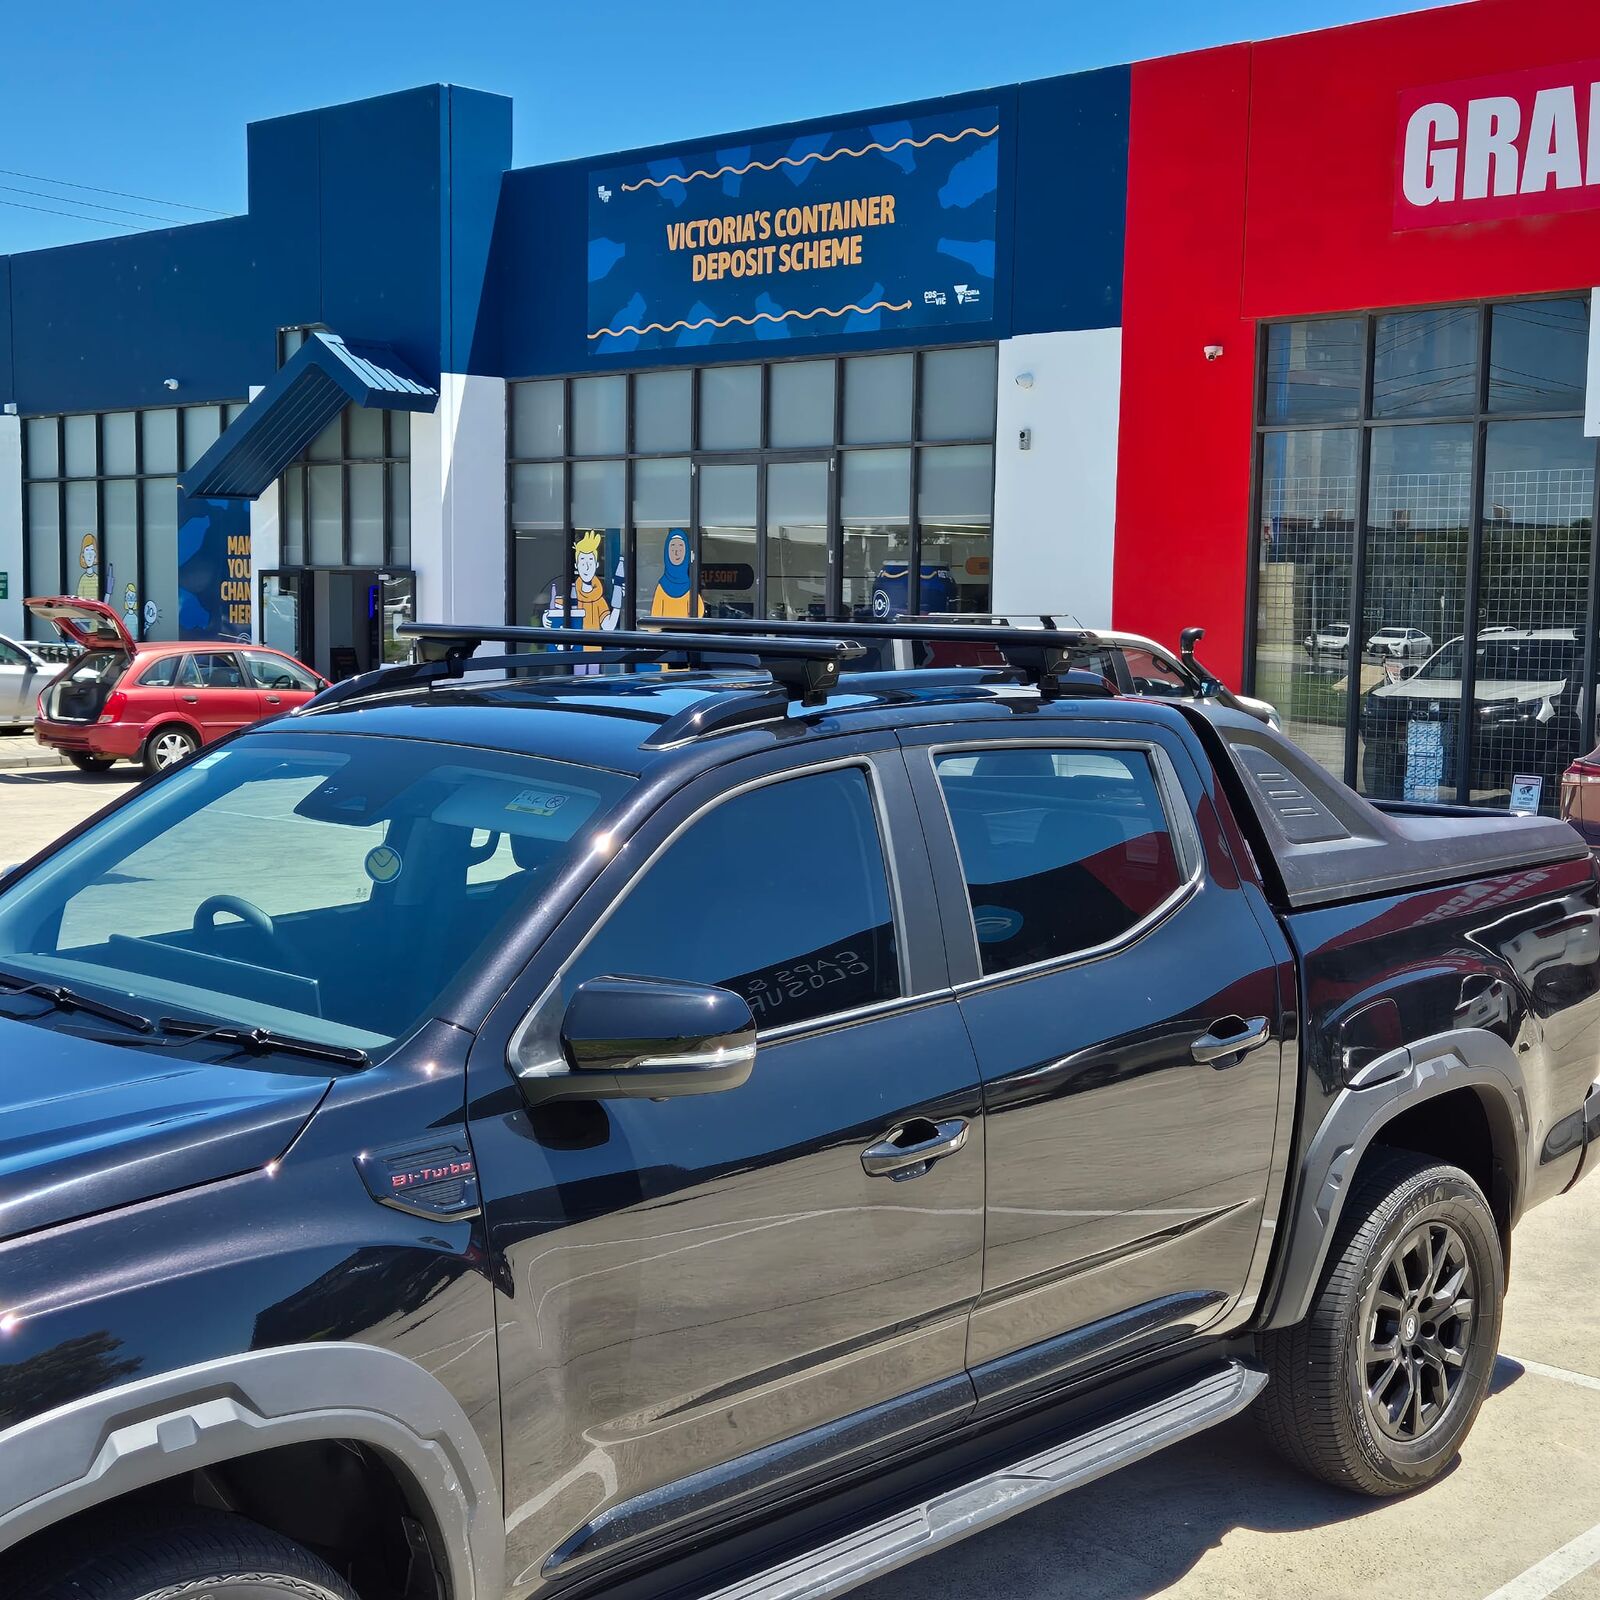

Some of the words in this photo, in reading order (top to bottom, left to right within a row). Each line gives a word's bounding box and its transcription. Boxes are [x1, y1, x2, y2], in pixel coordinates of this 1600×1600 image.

[1403, 82, 1600, 207] GRA
[666, 210, 771, 251] VICTORIA'S
[774, 194, 896, 238] CONTAINER
[692, 245, 776, 282] DEPOSIT
[778, 235, 863, 273] SCHEME
[935, 297, 947, 305] VIC
[391, 1161, 472, 1187] Bi-Turbo
